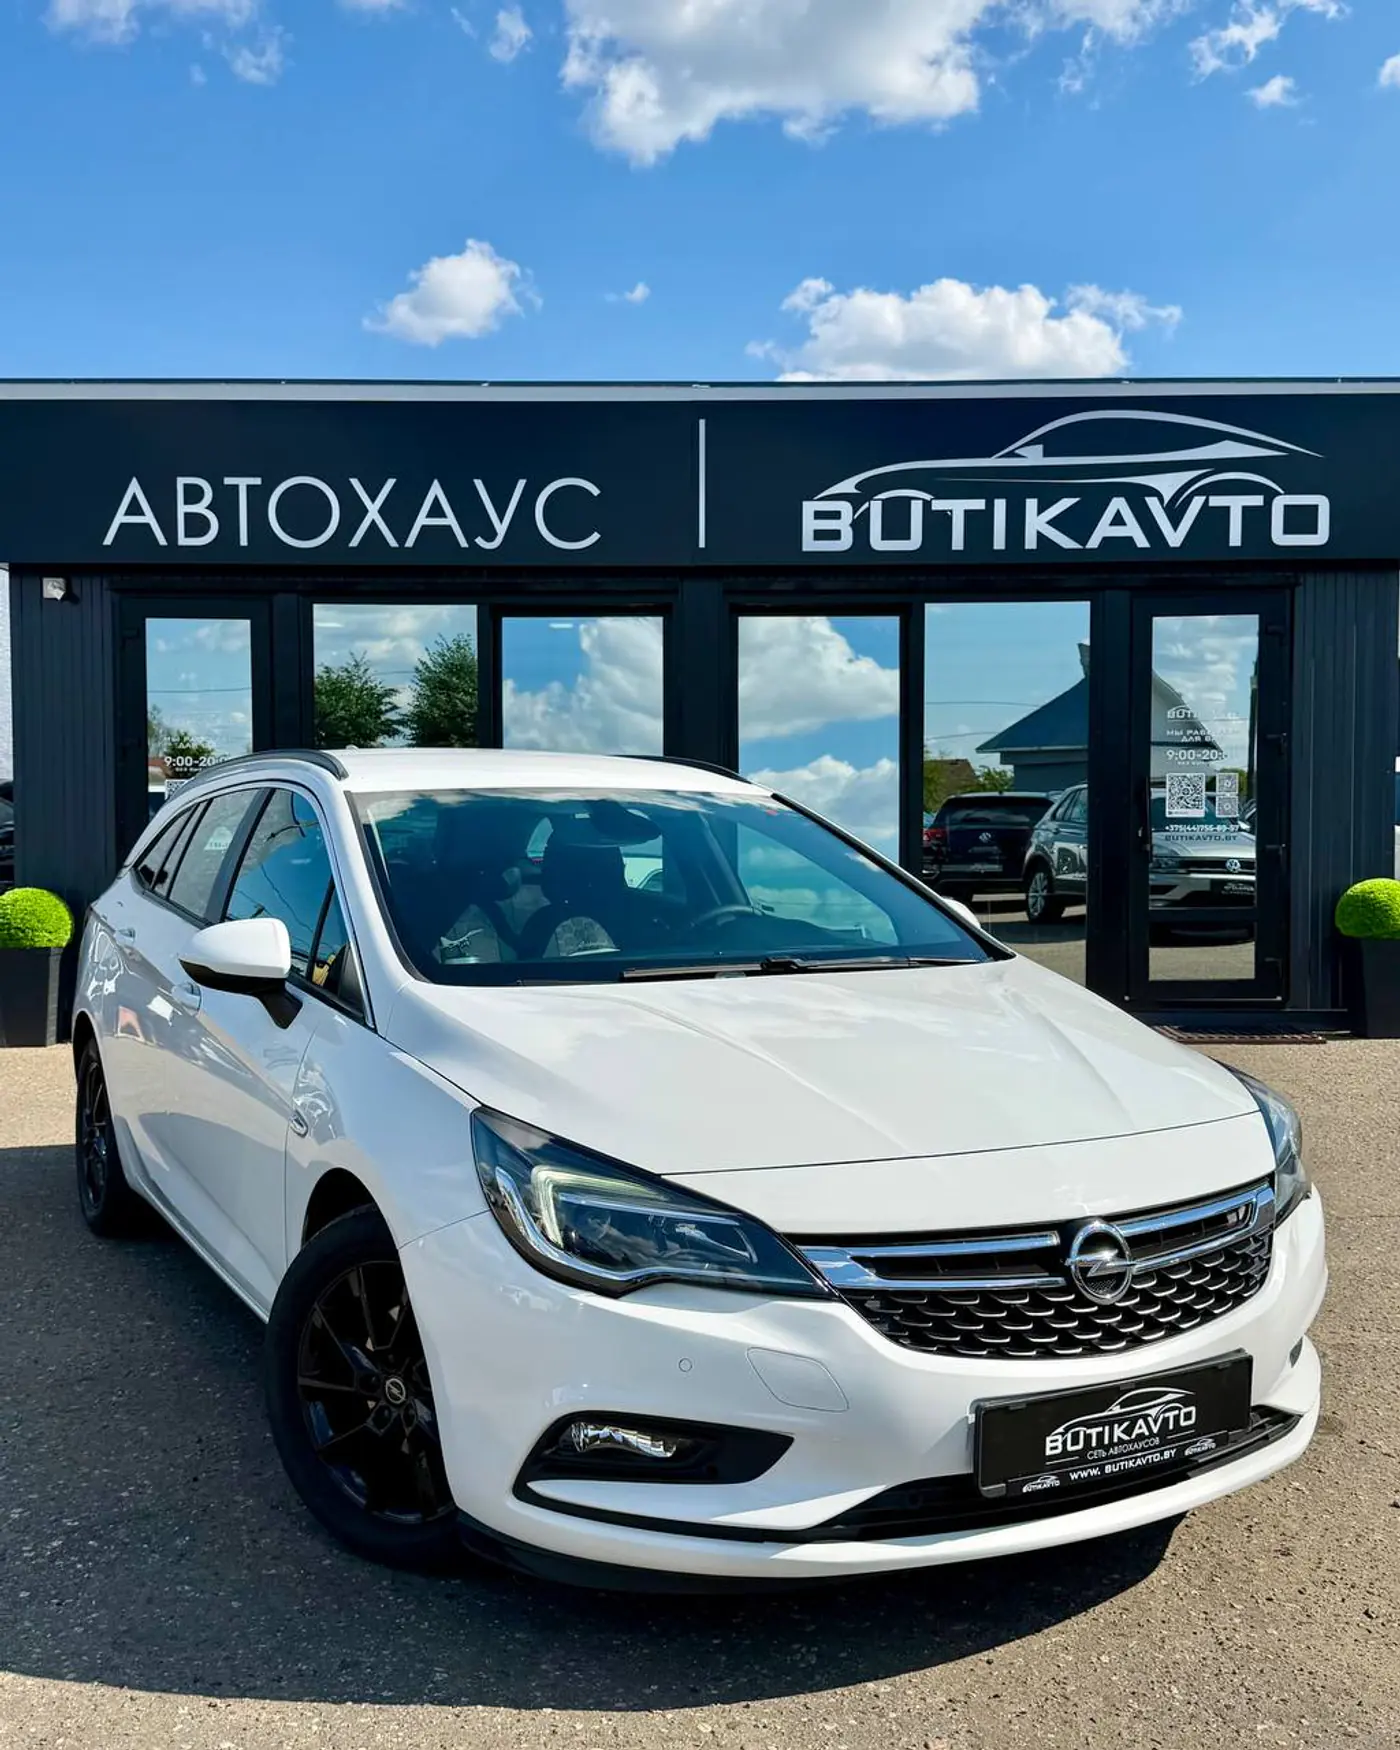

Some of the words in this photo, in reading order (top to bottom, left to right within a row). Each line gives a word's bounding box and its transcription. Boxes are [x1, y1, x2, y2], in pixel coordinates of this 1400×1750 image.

[103, 476, 601, 550] АВТОХАУС
[802, 494, 1330, 552] BUTIKAVTO
[1045, 1405, 1197, 1456] BUTIKAVTO
[1086, 1449, 1107, 1460] СЕТЬ
[1107, 1436, 1161, 1456] АВТОХАУСОВ
[1069, 1466, 1101, 1482] WWW.
[1105, 1448, 1178, 1475] BUTIKAVTO.BY
